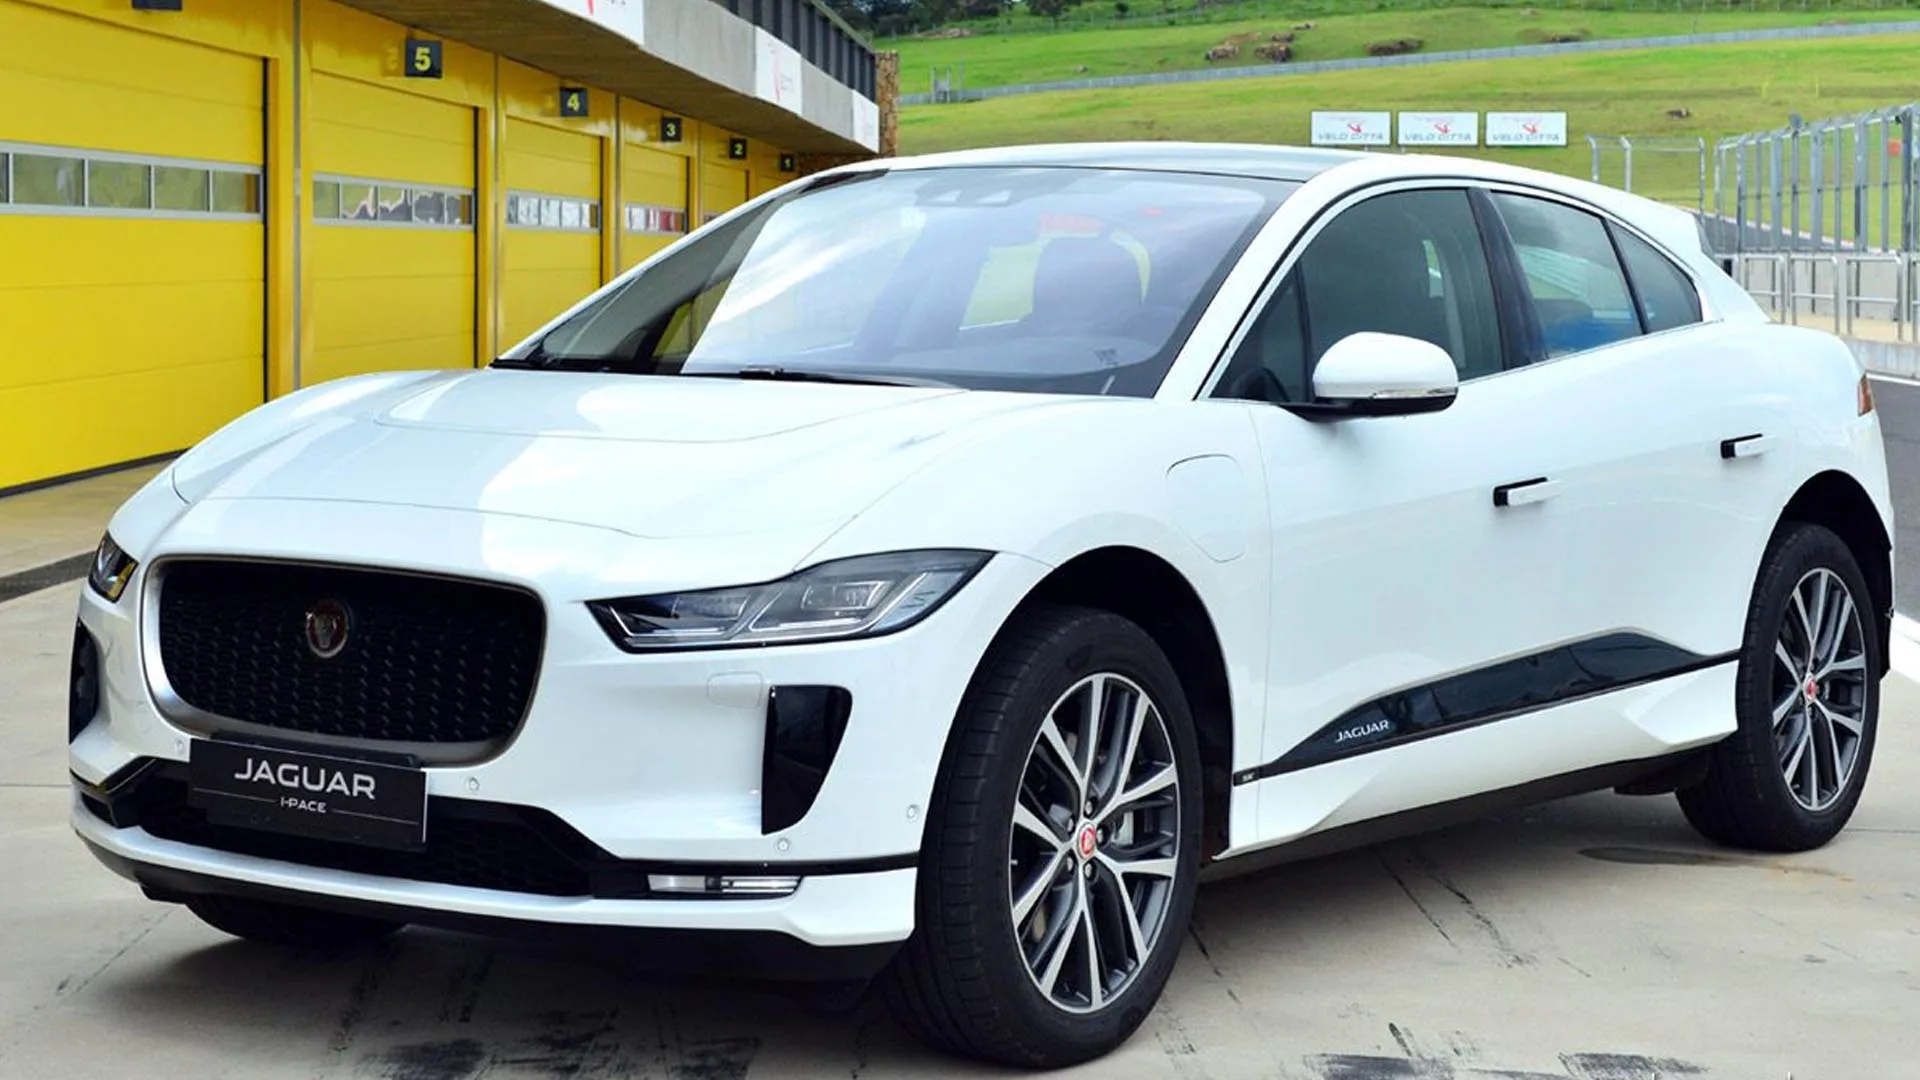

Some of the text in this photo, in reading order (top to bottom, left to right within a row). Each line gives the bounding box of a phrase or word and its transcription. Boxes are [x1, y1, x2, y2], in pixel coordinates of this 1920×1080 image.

[415, 46, 431, 71] 5
[567, 93, 580, 112] 4
[666, 122, 676, 137] 3
[734, 143, 743, 156] 2
[784, 158, 791, 169] 1
[1335, 719, 1390, 743] JAGUAR
[234, 758, 376, 800] JAGUAR
[280, 797, 327, 814] I-PACE
